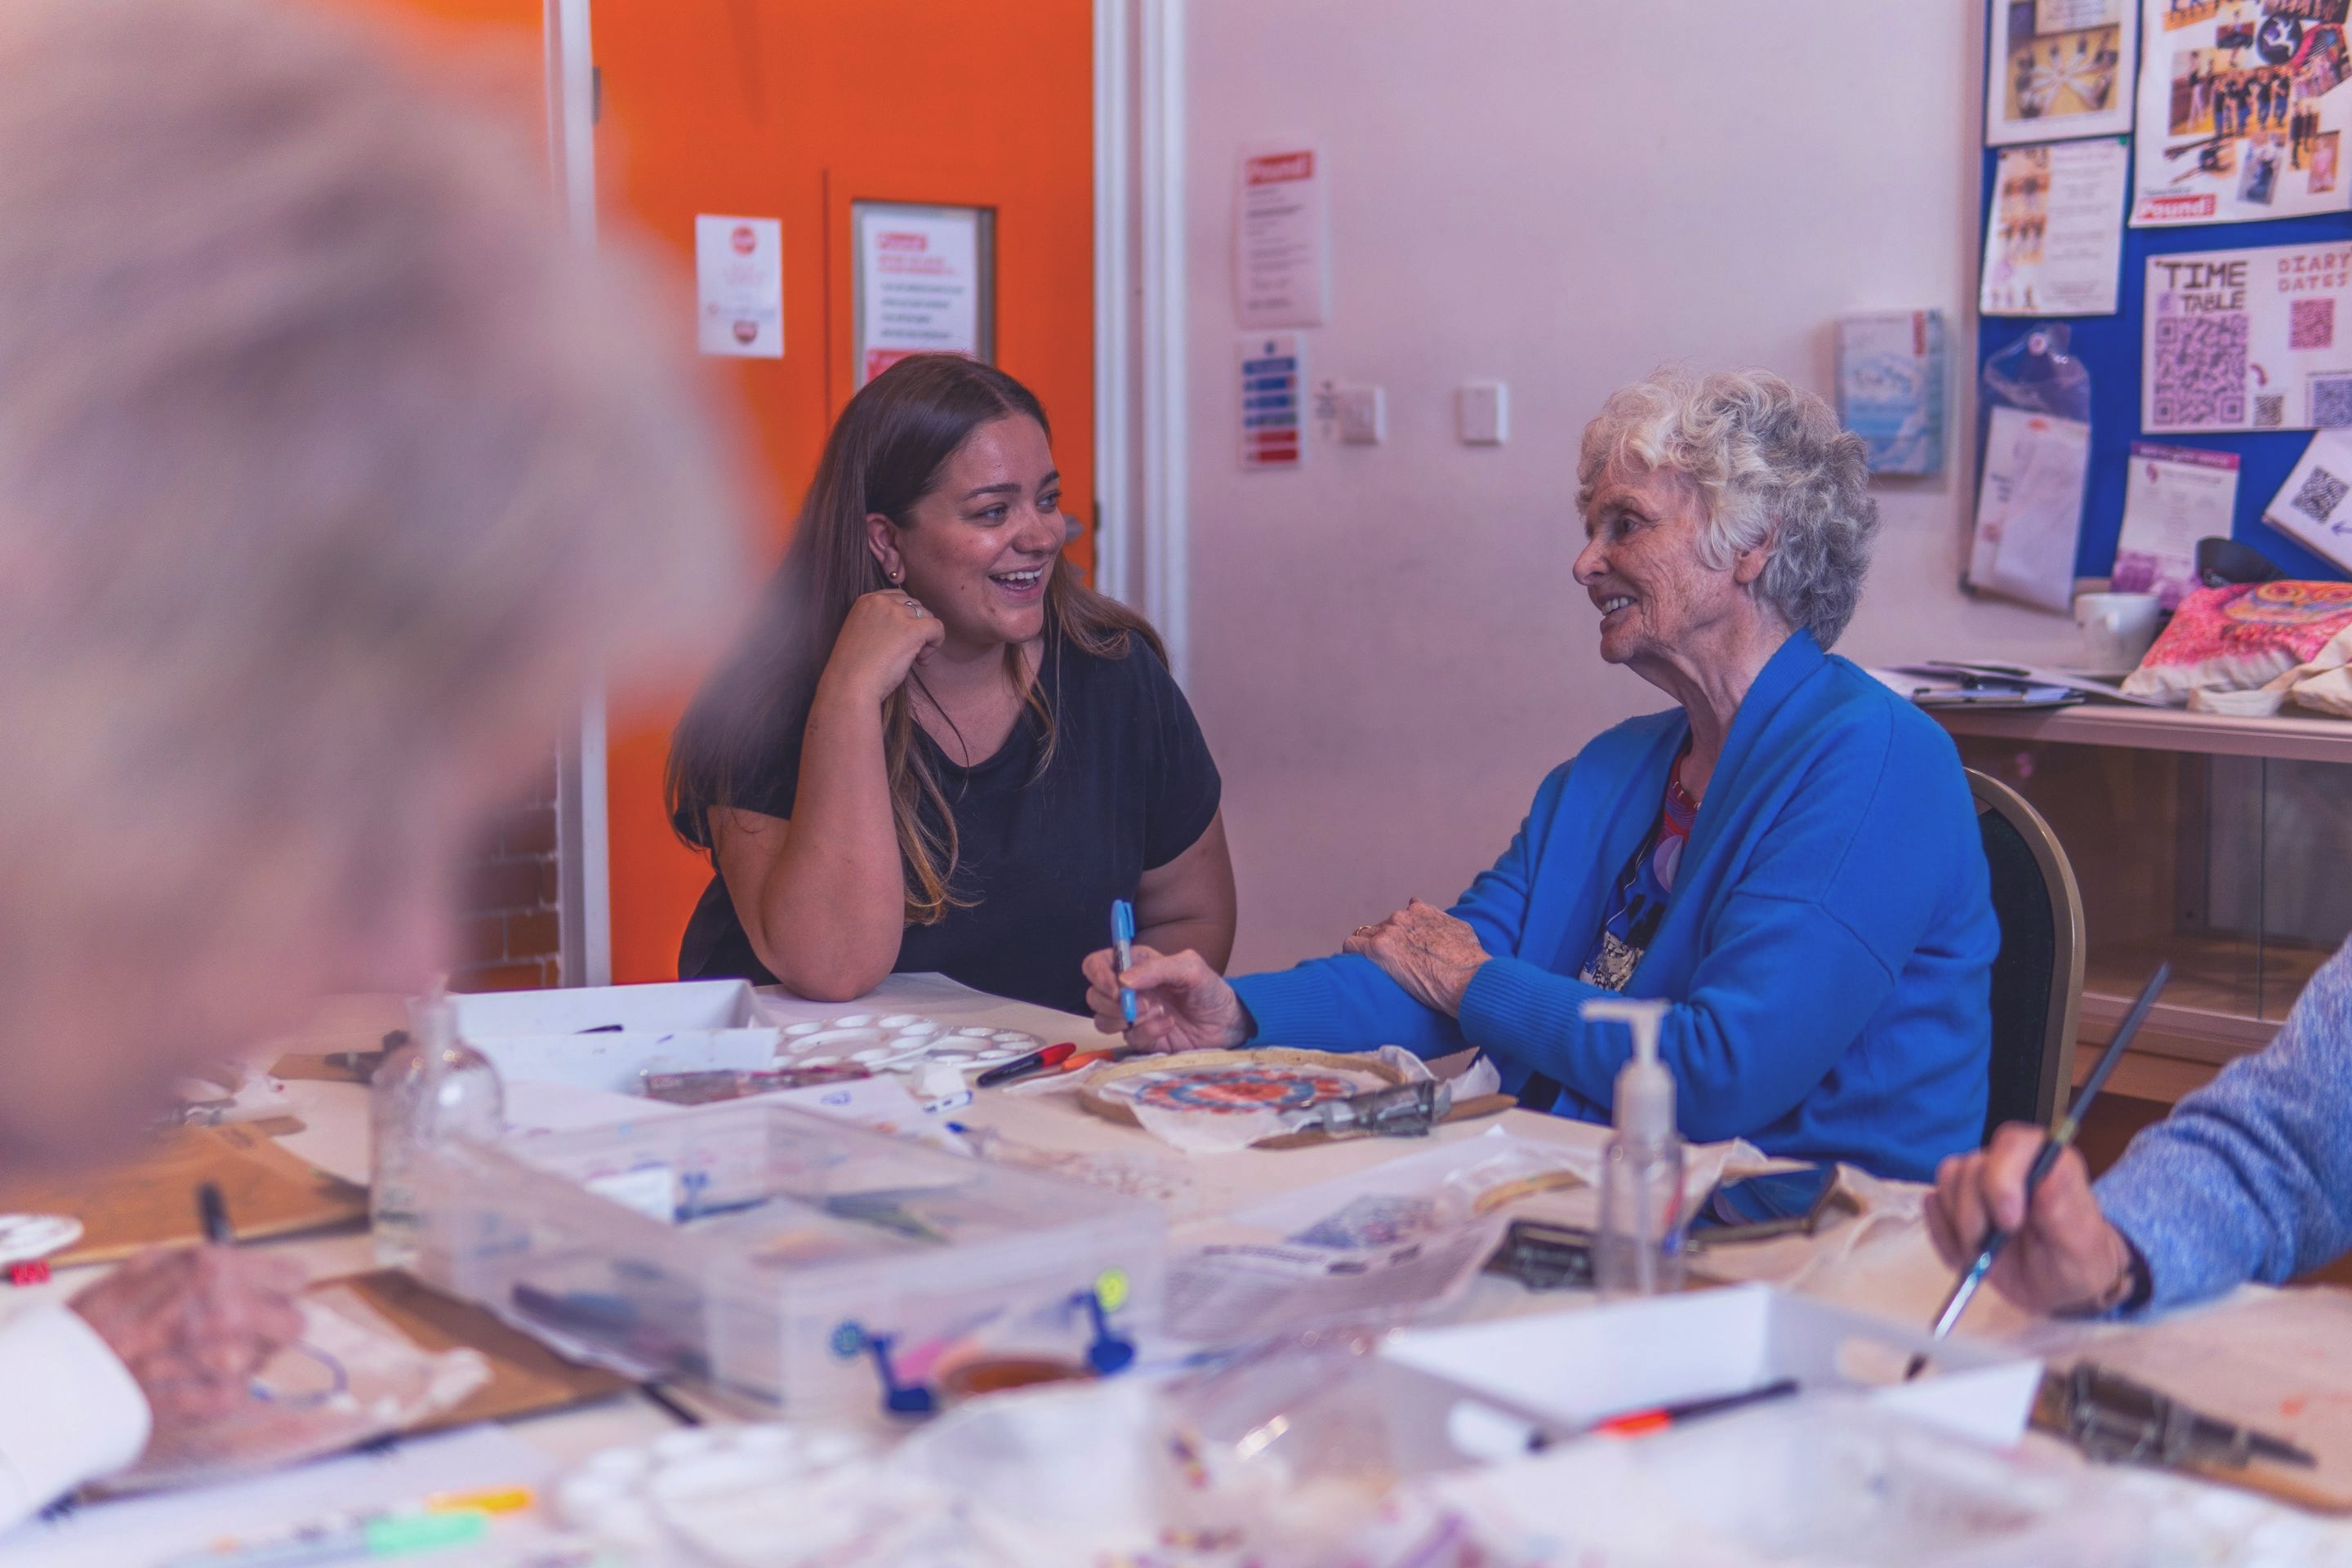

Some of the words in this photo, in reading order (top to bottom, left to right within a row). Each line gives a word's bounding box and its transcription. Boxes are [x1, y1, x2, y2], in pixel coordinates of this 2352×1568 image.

[2278, 252, 2350, 273] DIARY
[2156, 261, 2247, 288] TIME
[2278, 273, 2349, 292] DATES
[2181, 291, 2244, 313] TABLE
